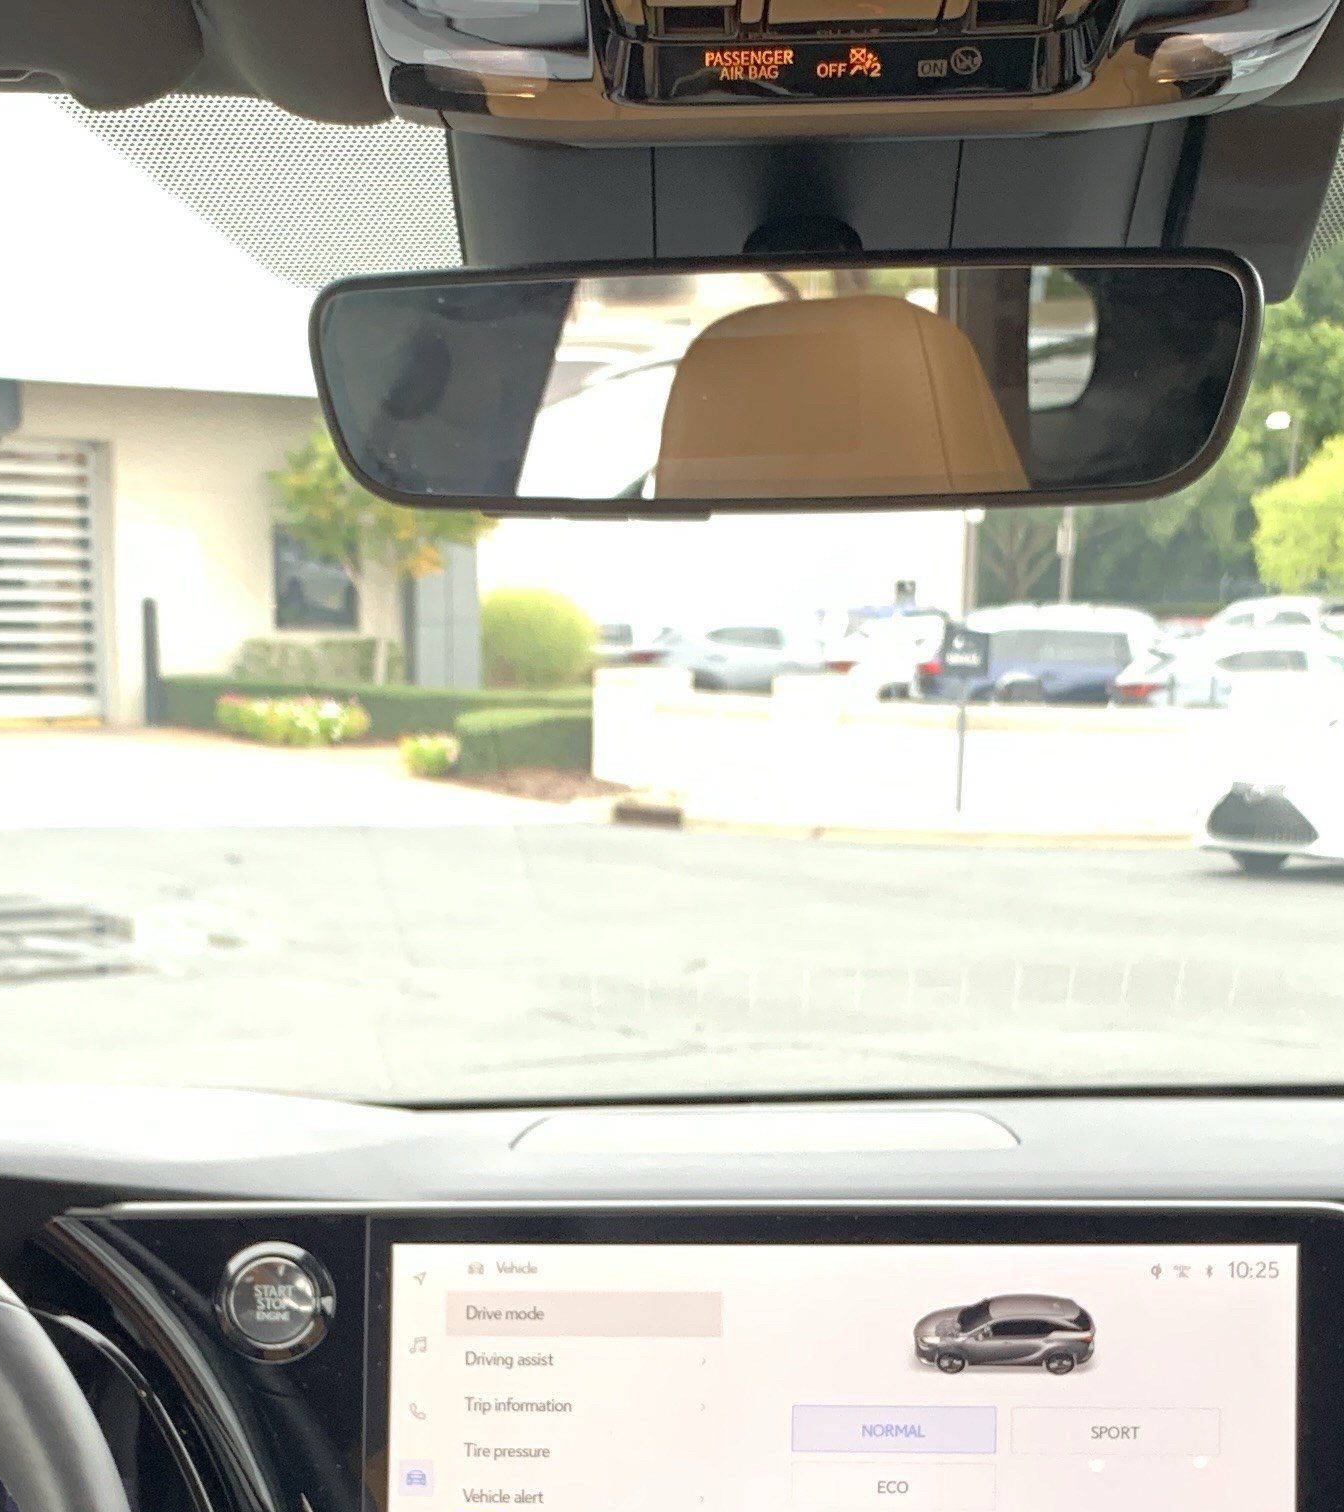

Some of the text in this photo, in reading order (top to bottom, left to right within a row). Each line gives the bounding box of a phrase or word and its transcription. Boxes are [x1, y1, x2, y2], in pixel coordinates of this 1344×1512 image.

[705, 49, 794, 67] PASSENGER
[719, 66, 779, 81] AIR BAG
[817, 63, 847, 78] OFF
[920, 62, 944, 77] ON
[496, 1261, 1280, 1280] Vehicle 10:25
[254, 1285, 293, 1297] START
[465, 1305, 545, 1322] Drive mode
[464, 1350, 554, 1370] Driving assist
[464, 1395, 573, 1415] Trip information
[861, 1423, 1140, 1441] NORMAL SPORT
[464, 1442, 551, 1462] Tire pressure
[462, 1487, 544, 1505] Vehicle alert
[877, 1480, 909, 1496] ECO
